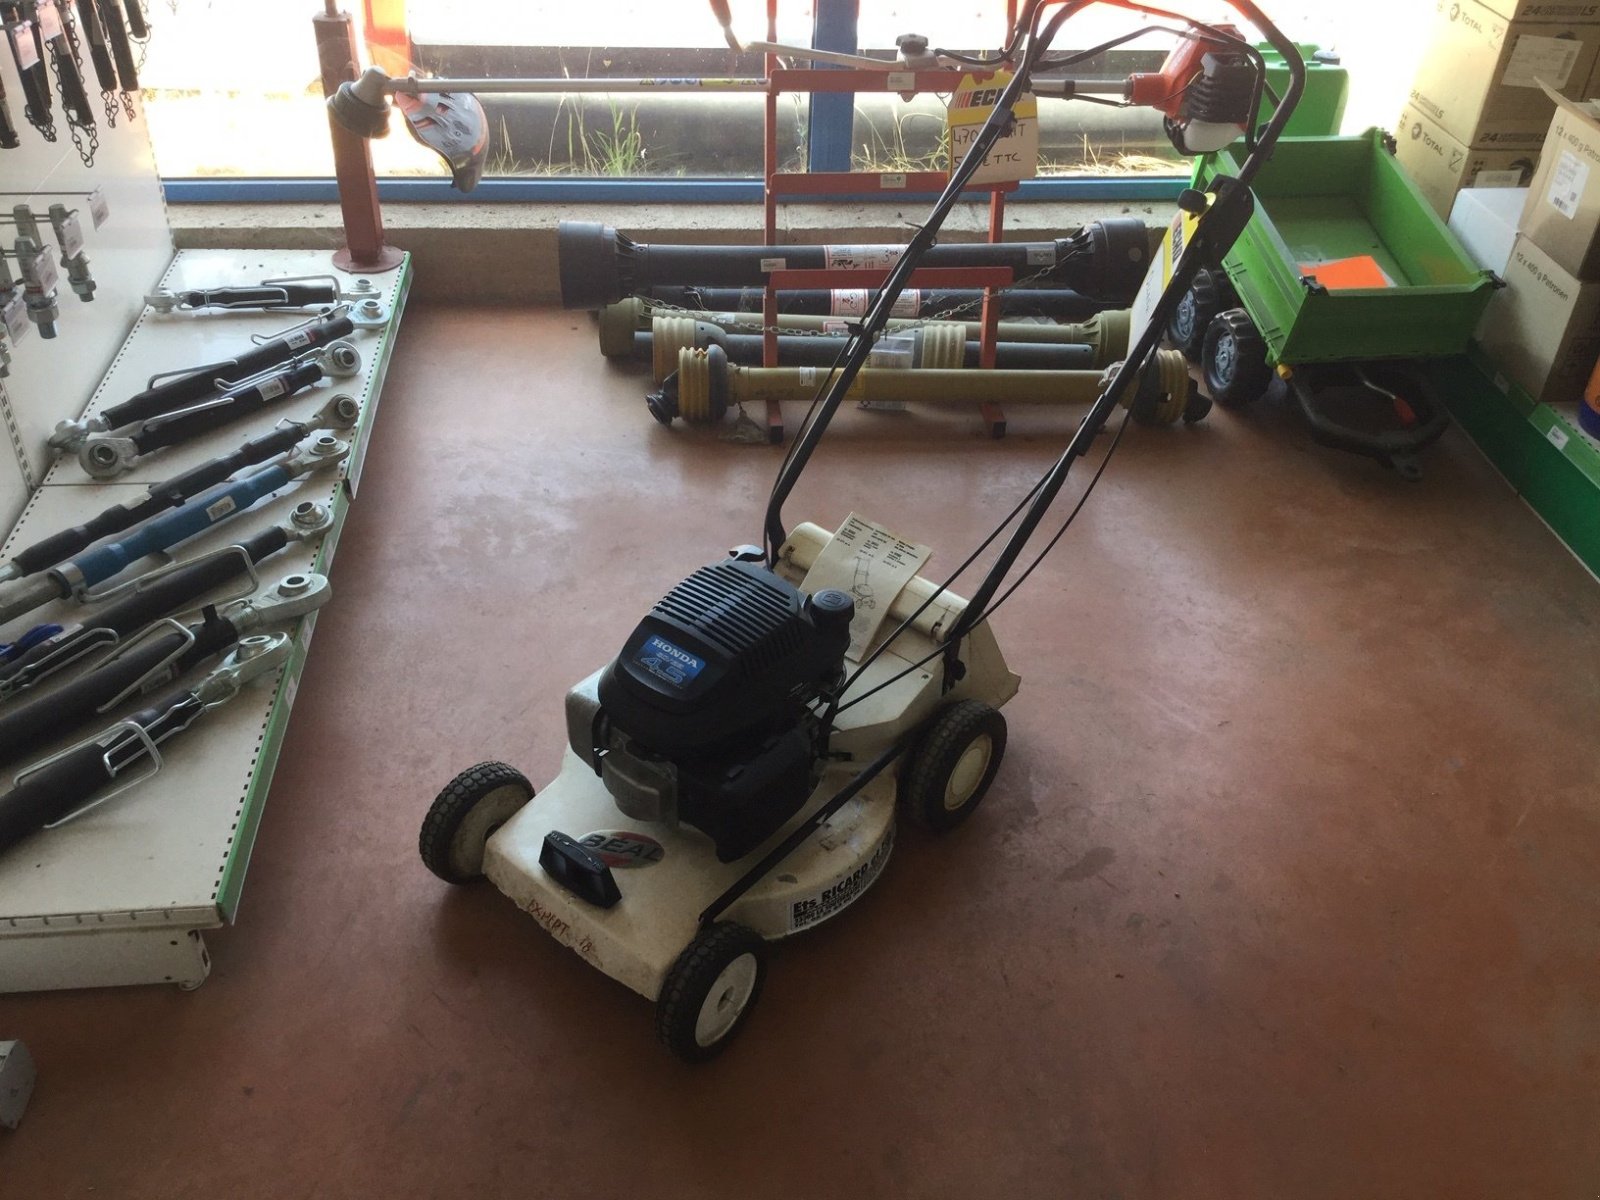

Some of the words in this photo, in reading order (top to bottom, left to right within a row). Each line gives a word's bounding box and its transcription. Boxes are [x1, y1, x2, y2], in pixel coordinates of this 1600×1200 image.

[1461, 11, 1483, 34] TOTAL
[1423, 131, 1445, 157] TOTAL
[1479, 132, 1498, 143] 24
[993, 152, 1022, 165] TTC
[651, 638, 698, 668] HONDA
[793, 898, 818, 915] Ets
[821, 862, 869, 903] RICARD
